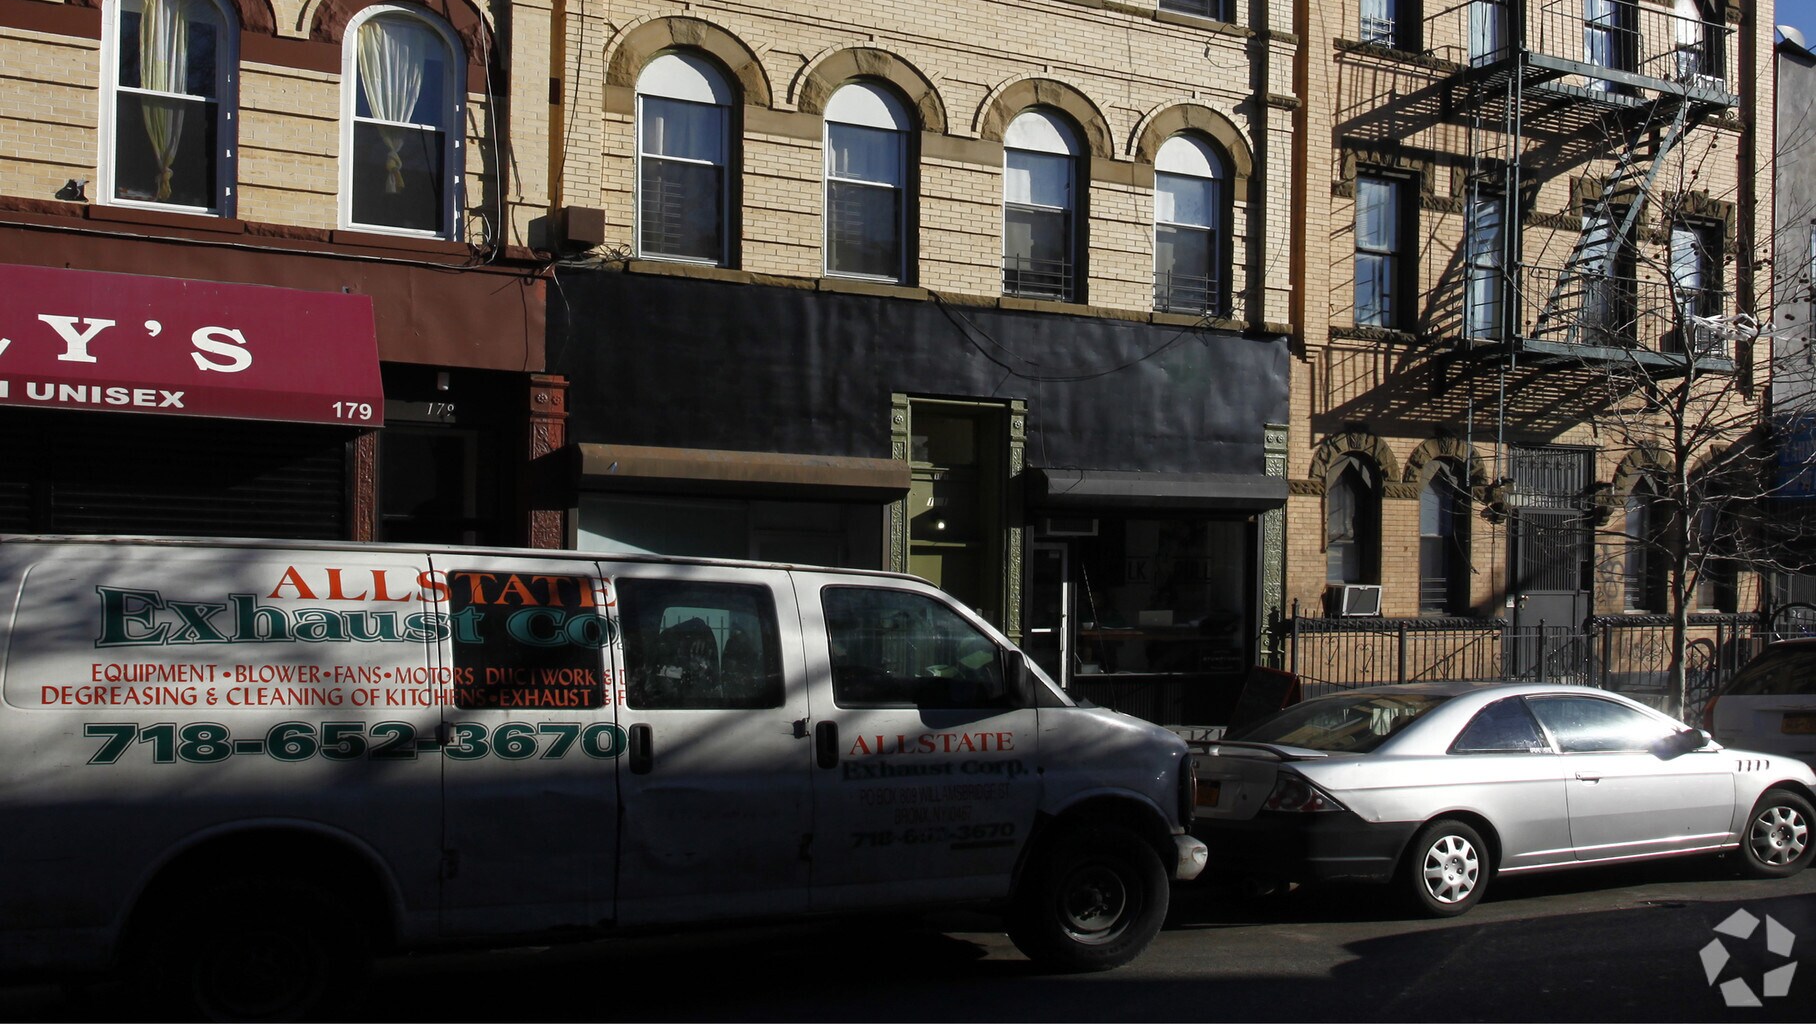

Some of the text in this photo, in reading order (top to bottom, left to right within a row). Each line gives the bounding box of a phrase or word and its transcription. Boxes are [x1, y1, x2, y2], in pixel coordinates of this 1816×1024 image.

[0, 313, 253, 373] Y'S
[26, 381, 185, 409] UNISEX
[332, 401, 372, 420] 179
[427, 402, 455, 417] 179
[266, 566, 617, 608] ALLSTATE
[95, 585, 622, 651] Exhaust Co
[91, 663, 218, 683] EQUIPMENT
[234, 664, 321, 684] BLOWER
[334, 666, 381, 684] FANS
[394, 667, 475, 686] MOTORS
[41, 686, 198, 706] DEGREASING
[206, 688, 219, 705] &
[226, 687, 344, 706] CLEANING
[351, 688, 380, 707] OF
[386, 688, 487, 707] KITCHENS
[499, 688, 592, 707] EXHAUST
[83, 721, 629, 765] 718-652-3670
[850, 732, 1015, 756] ALLSTATE
[842, 758, 1029, 780] Exhaust Corp.
